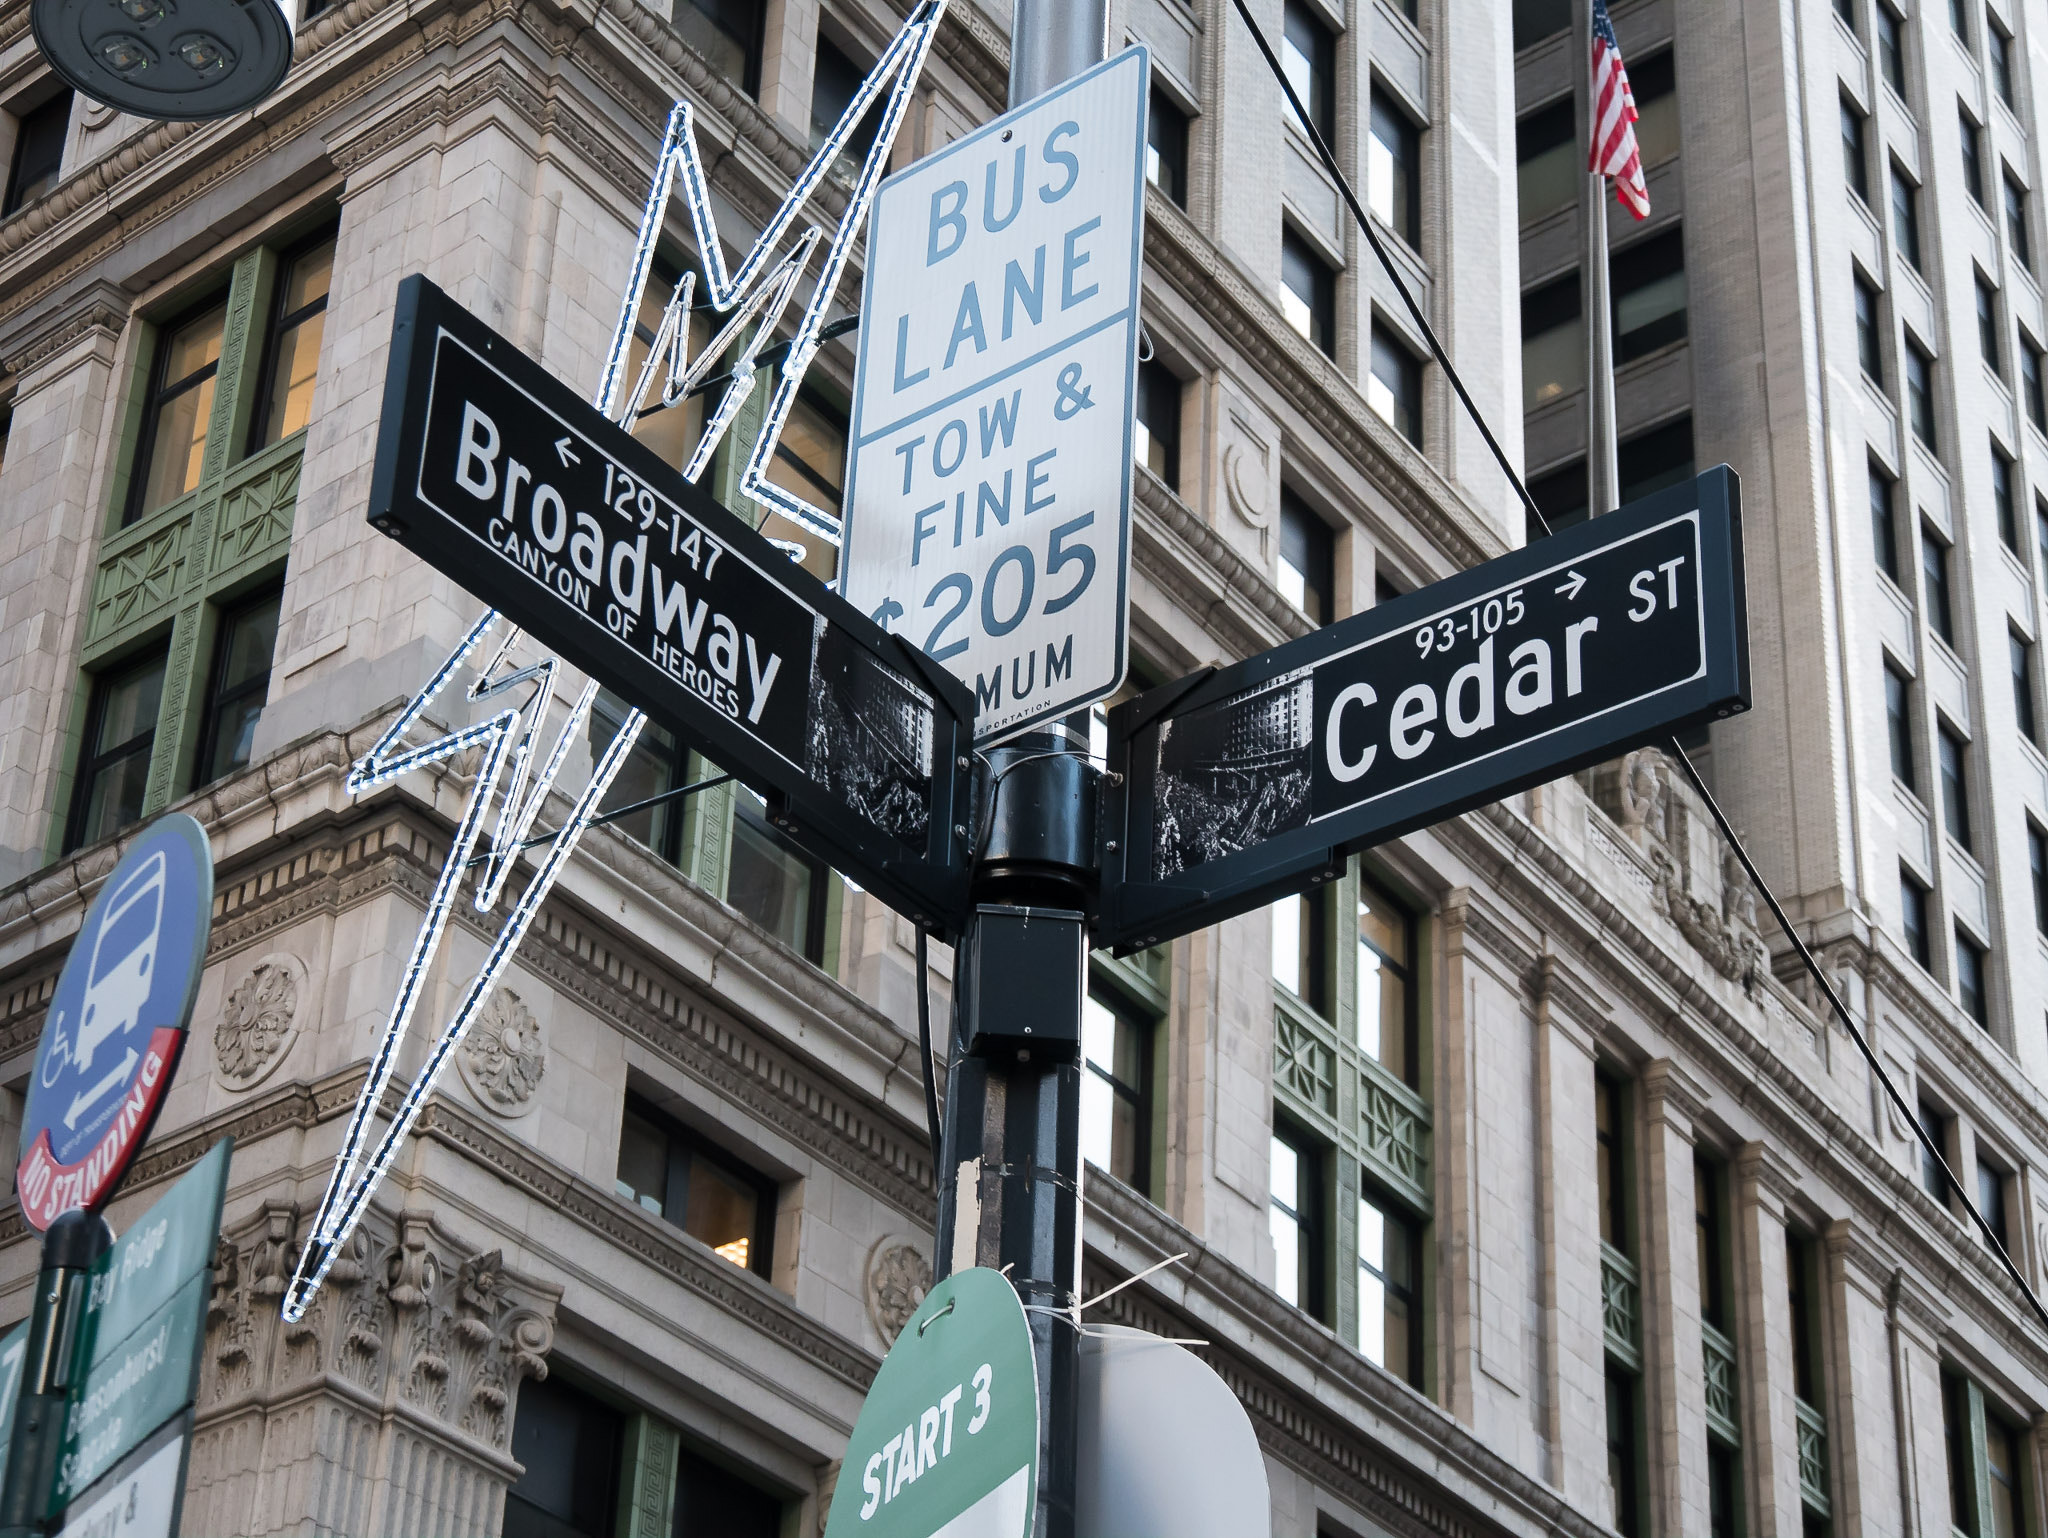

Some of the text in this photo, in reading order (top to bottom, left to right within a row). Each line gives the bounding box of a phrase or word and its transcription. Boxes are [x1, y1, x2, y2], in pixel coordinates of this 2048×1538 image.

[927, 121, 1080, 267] BUS
[893, 215, 1101, 394] LANE
[895, 362, 1095, 496] TOW &
[455, 400, 782, 725] Broadway
[604, 463, 723, 581] 129-147
[911, 448, 1057, 567] FINE
[488, 518, 739, 717] CANYON OF HEROES
[961, 634, 1073, 718] MUM
[1326, 556, 1685, 782] Cedar ST
[1415, 589, 1525, 659] 93-105
[23, 1147, 51, 1210] NO
[44, 1051, 163, 1221] STANDING
[121, 1218, 168, 1283] Ridge
[860, 1363, 993, 1520] START 3
